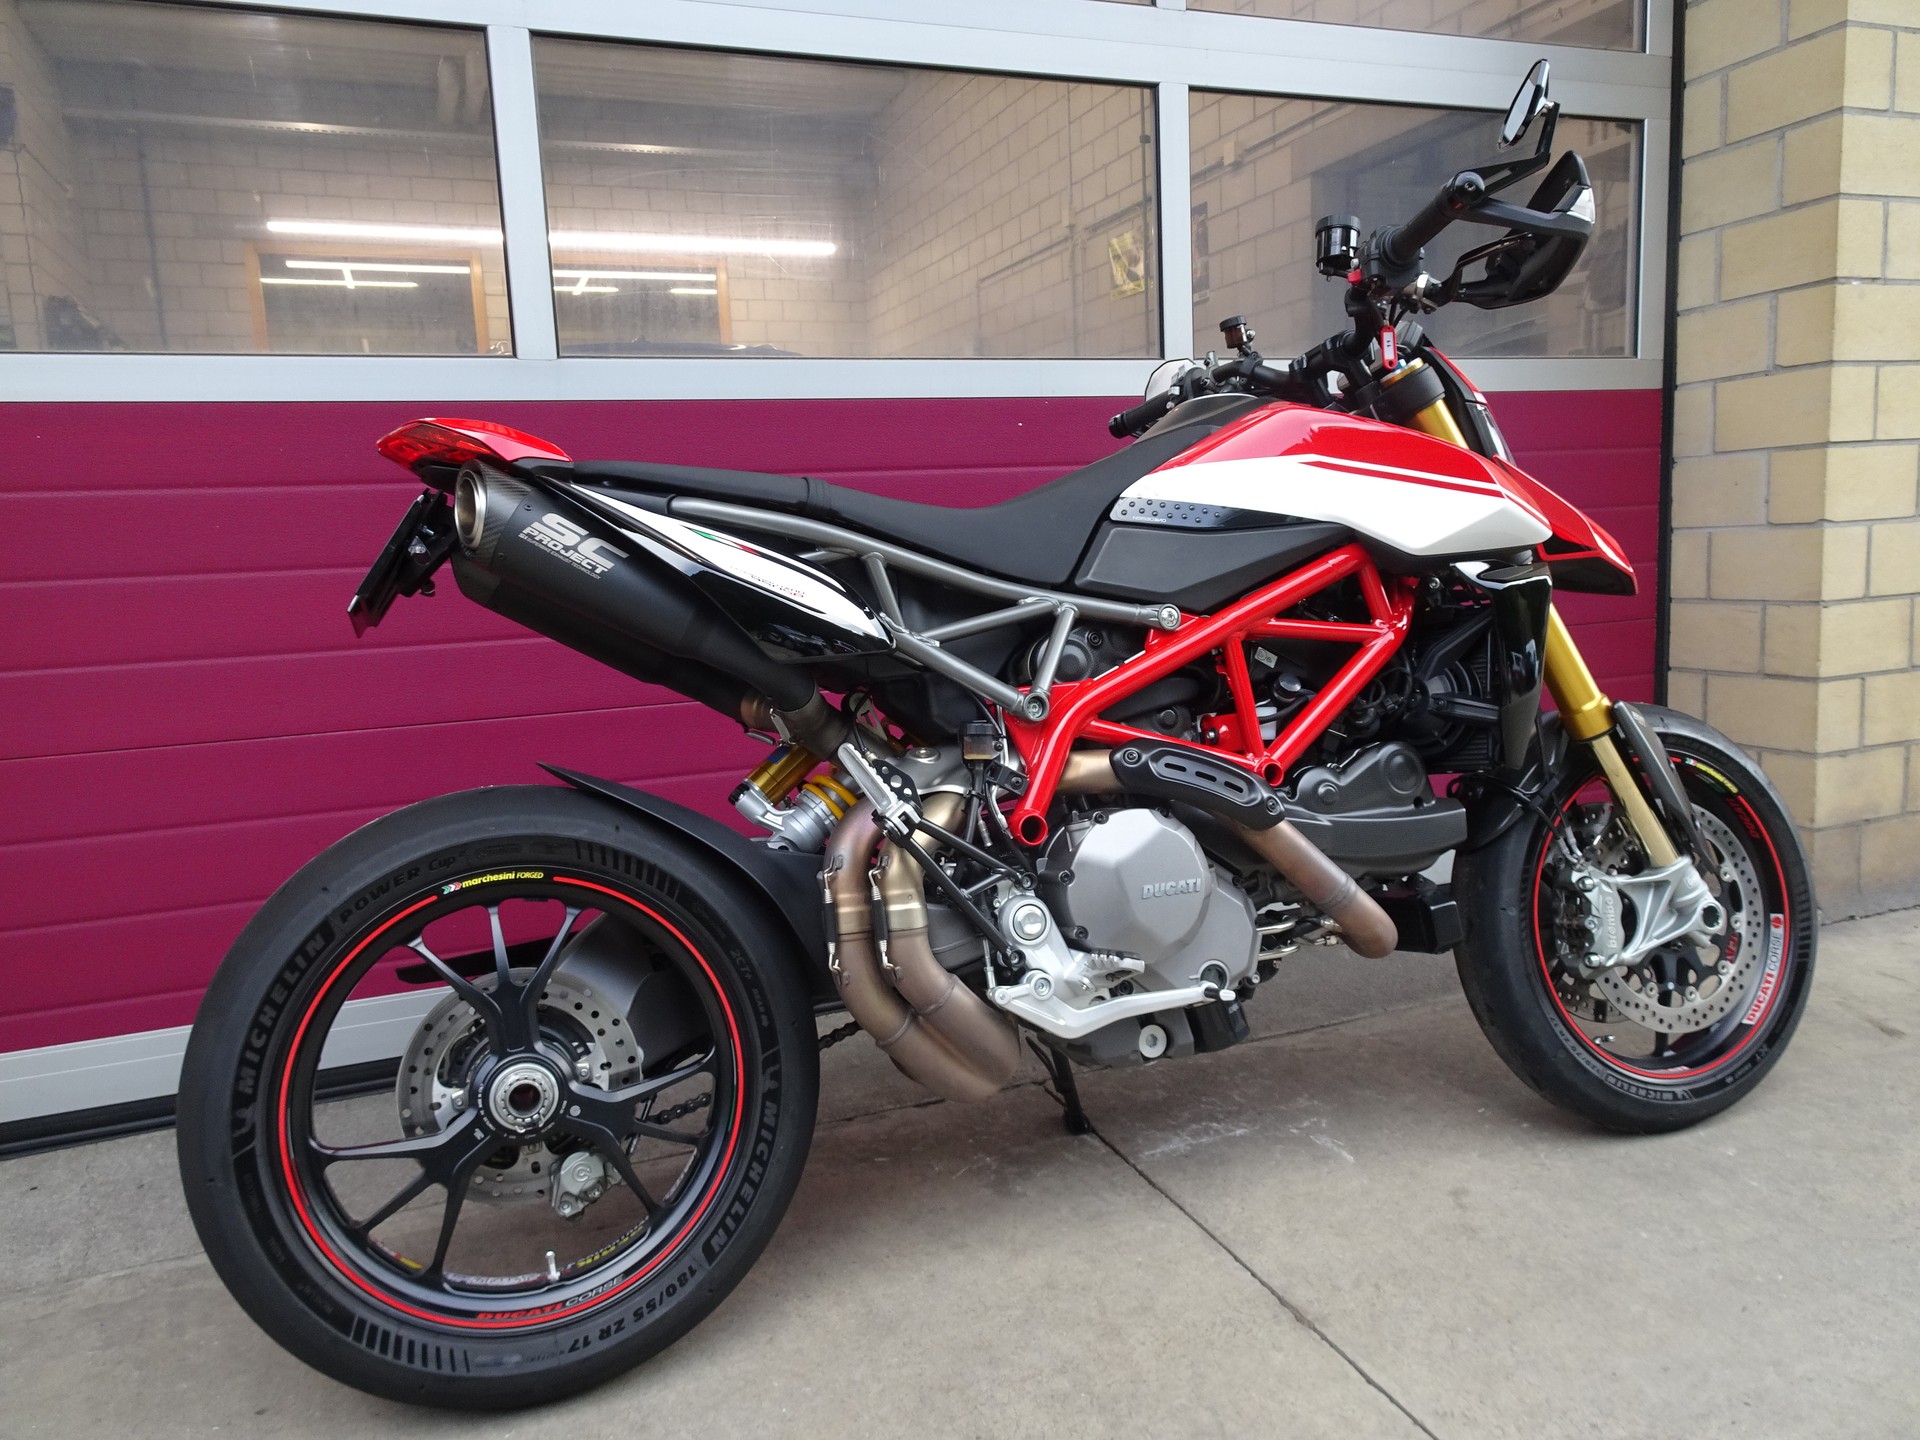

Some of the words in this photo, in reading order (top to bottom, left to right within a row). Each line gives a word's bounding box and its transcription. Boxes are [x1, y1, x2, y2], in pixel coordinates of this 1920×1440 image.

[522, 526, 609, 574] PROJECT
[530, 513, 630, 569] SC
[571, 562, 601, 579] TECHNOLOGY
[340, 867, 420, 924] POWER
[462, 871, 515, 888] marchesini
[516, 871, 544, 879] FORGED
[1141, 878, 1201, 899] DUCATI
[1604, 896, 1618, 949] brembo
[238, 933, 326, 1094] MICHELIN
[1746, 972, 1775, 1021] DUCATI
[1607, 1075, 1675, 1100] MICHELIN
[710, 1100, 777, 1253] MICHELIN
[476, 1303, 563, 1319] DUCATI
[565, 1274, 625, 1307] CORSE
[632, 1264, 697, 1323] 180/55
[567, 1335, 592, 1353] 17
[598, 1318, 626, 1341] ZR
